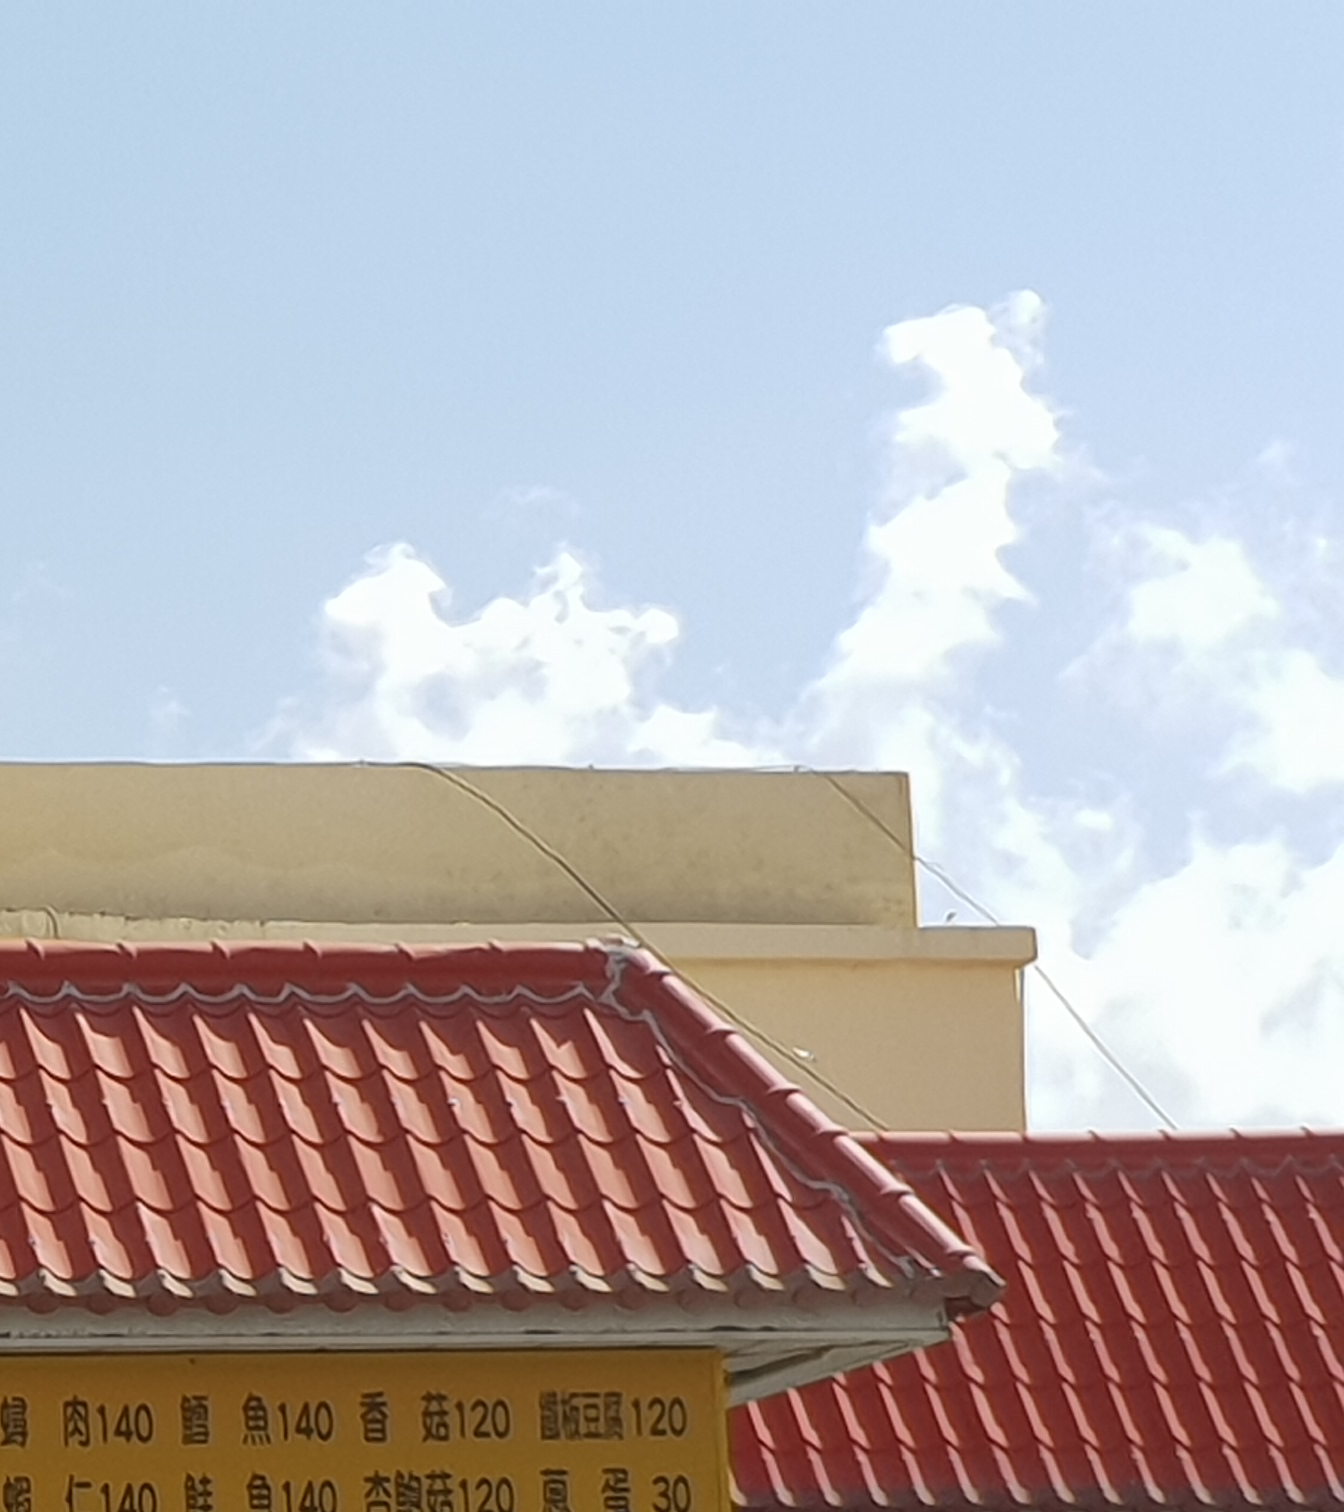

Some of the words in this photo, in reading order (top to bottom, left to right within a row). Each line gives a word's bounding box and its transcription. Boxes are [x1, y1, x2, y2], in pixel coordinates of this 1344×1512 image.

[96, 1403, 154, 1445] 140
[278, 1401, 334, 1442] 140
[455, 1399, 511, 1440] 120
[631, 1397, 687, 1438] 120
